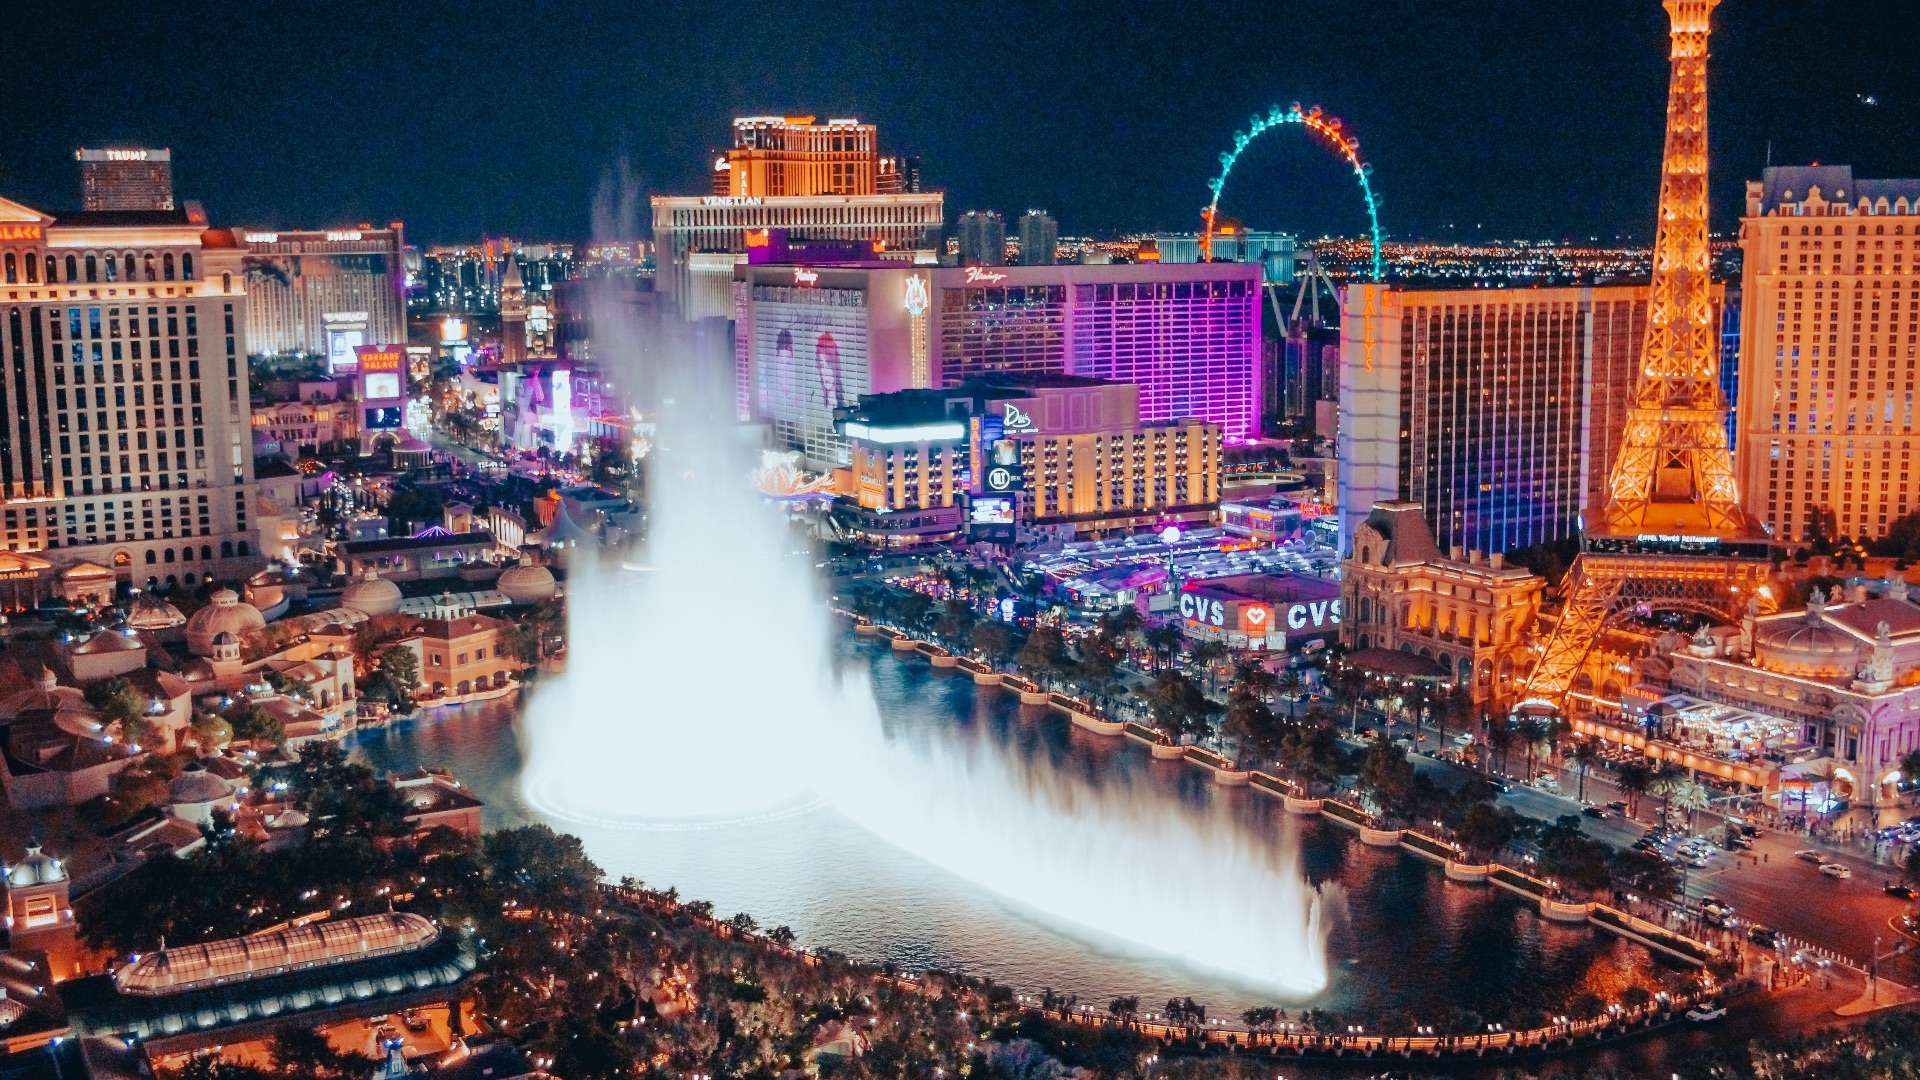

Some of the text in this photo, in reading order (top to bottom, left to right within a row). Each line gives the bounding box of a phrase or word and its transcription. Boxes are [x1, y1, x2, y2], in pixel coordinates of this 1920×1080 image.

[107, 150, 147, 161] TRUMP
[703, 196, 762, 206] VENETIAN
[965, 266, 1007, 284] Flamingo
[360, 352, 400, 362] CAESARS
[363, 360, 399, 370] PALACE
[1637, 534, 1719, 543] EIFFEL TOWER RESTAURANT
[1180, 593, 1224, 626] CVS
[1287, 599, 1341, 630] CVS
[1621, 686, 1659, 702] BEER PARK
